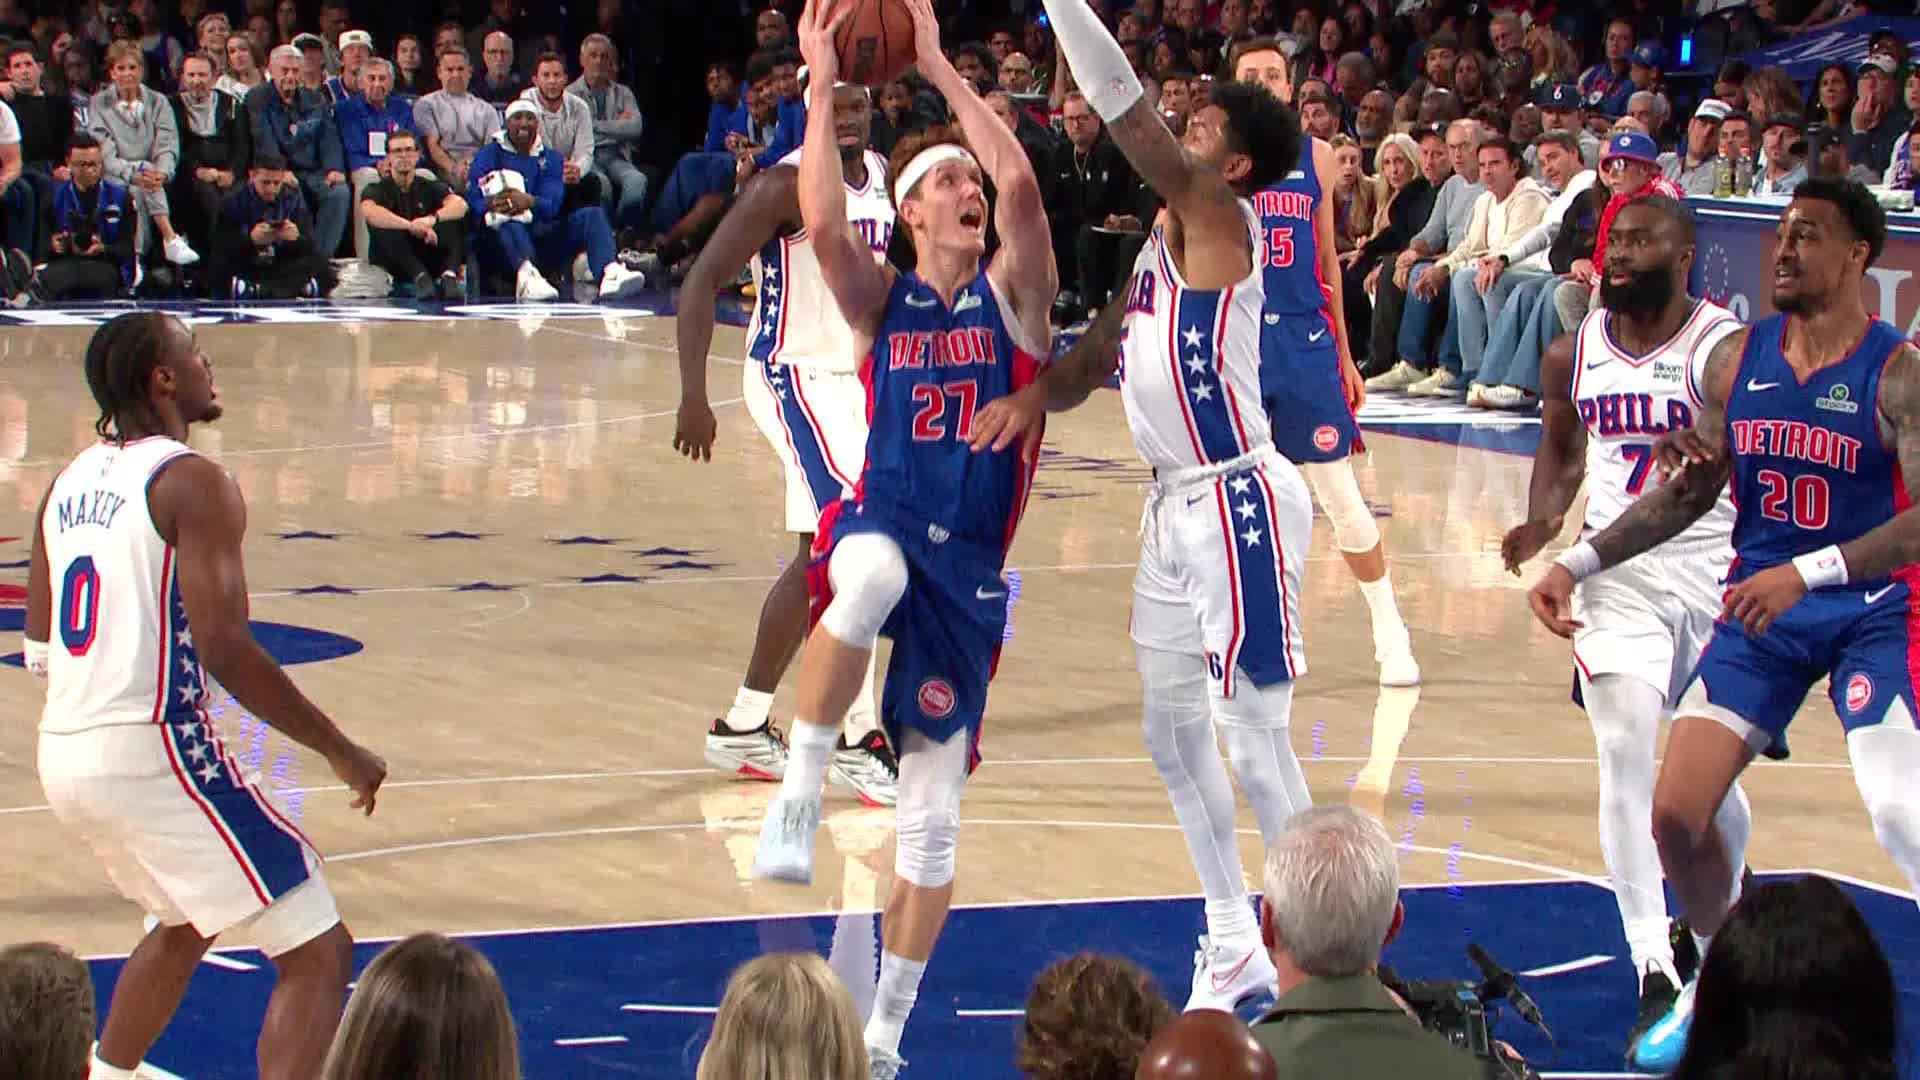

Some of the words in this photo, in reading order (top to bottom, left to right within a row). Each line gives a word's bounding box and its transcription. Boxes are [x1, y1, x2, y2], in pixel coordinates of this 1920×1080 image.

[1251, 190, 1313, 221] TROIT
[1262, 227, 1294, 268] 5
[912, 378, 978, 441] 27
[1578, 392, 1693, 437] PHILA
[1621, 444, 1656, 495] 7
[1731, 419, 1862, 474] DETROIT
[58, 490, 126, 533] MAXEY
[1757, 469, 1830, 530] 20
[59, 555, 101, 656] 0
